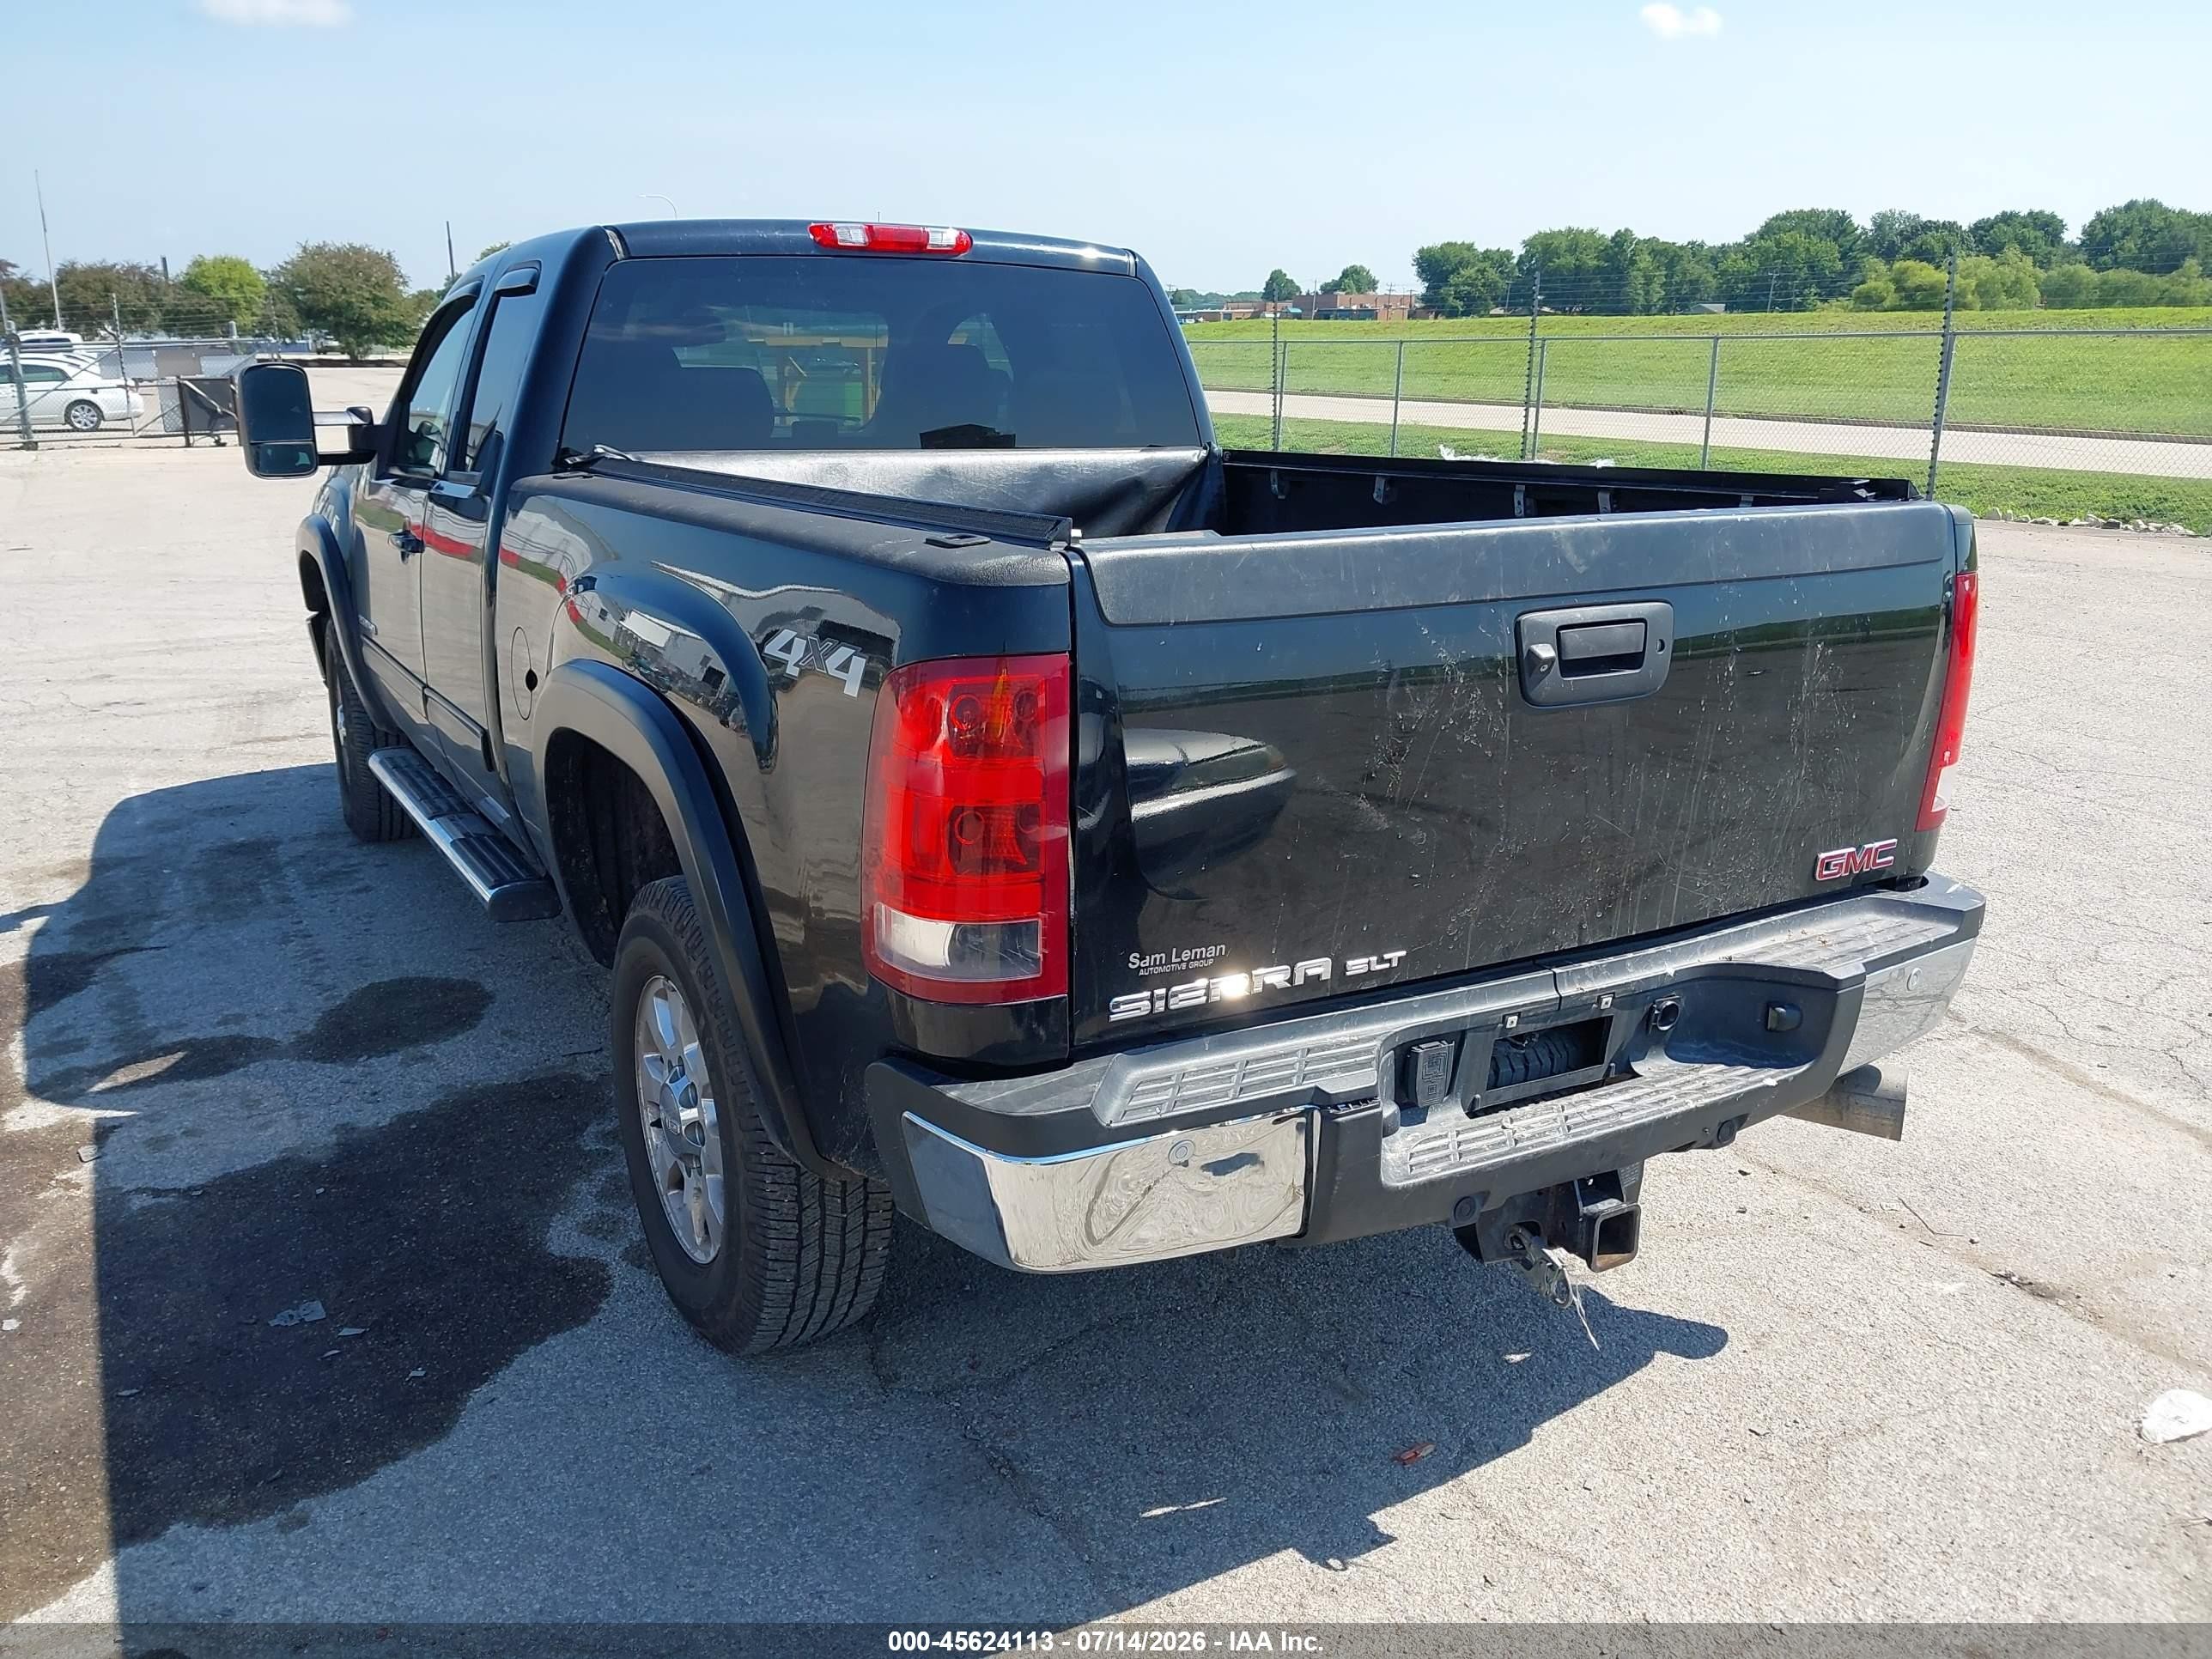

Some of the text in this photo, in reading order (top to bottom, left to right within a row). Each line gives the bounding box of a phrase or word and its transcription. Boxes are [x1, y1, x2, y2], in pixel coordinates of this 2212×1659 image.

[1815, 838, 1898, 881] GMC
[1128, 945, 1226, 969] Sam Leman
[1139, 958, 1214, 976] AUTOMOTIVE GROUP
[1109, 950, 1407, 1023] SIERRA SLT
